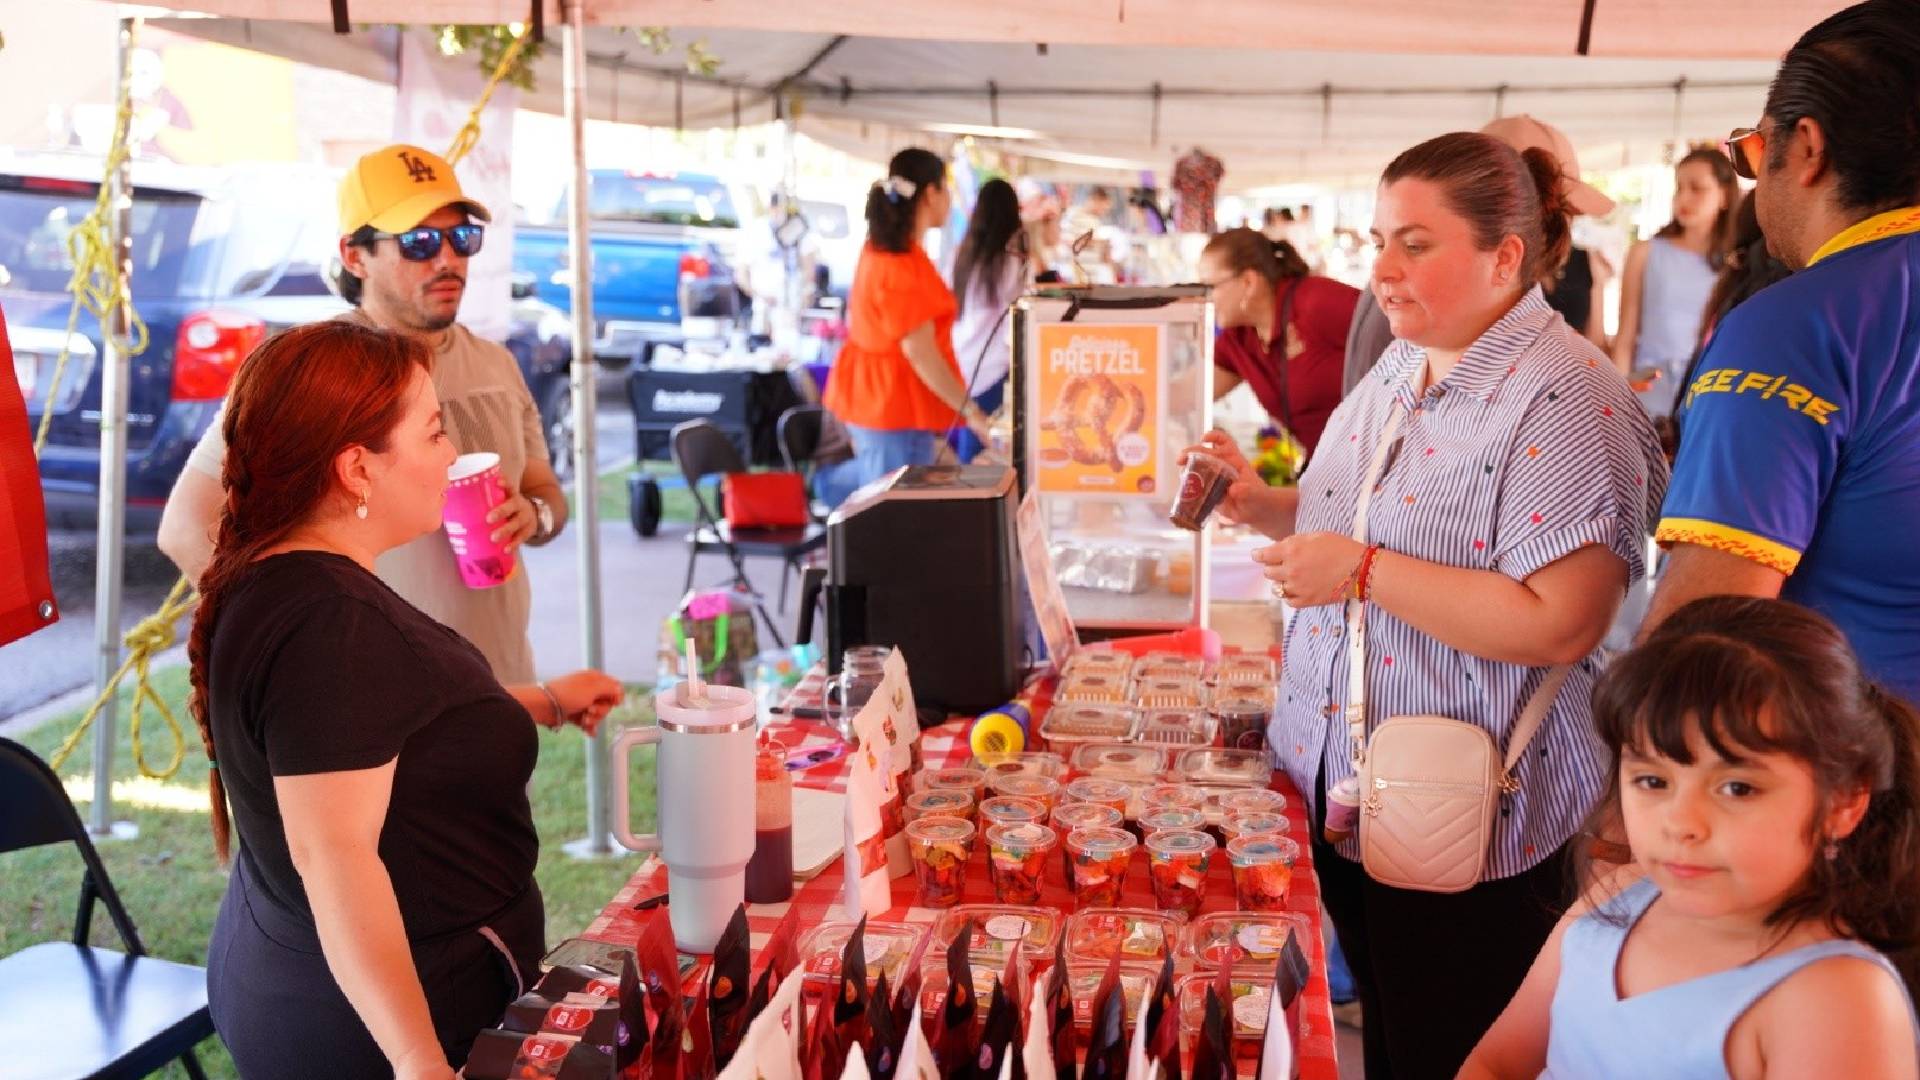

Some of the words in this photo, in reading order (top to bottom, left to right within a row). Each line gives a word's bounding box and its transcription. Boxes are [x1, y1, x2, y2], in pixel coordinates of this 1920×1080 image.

[397, 151, 438, 183] LA
[1050, 347, 1146, 375] PRETZEL
[1735, 371, 1841, 426] FIRE
